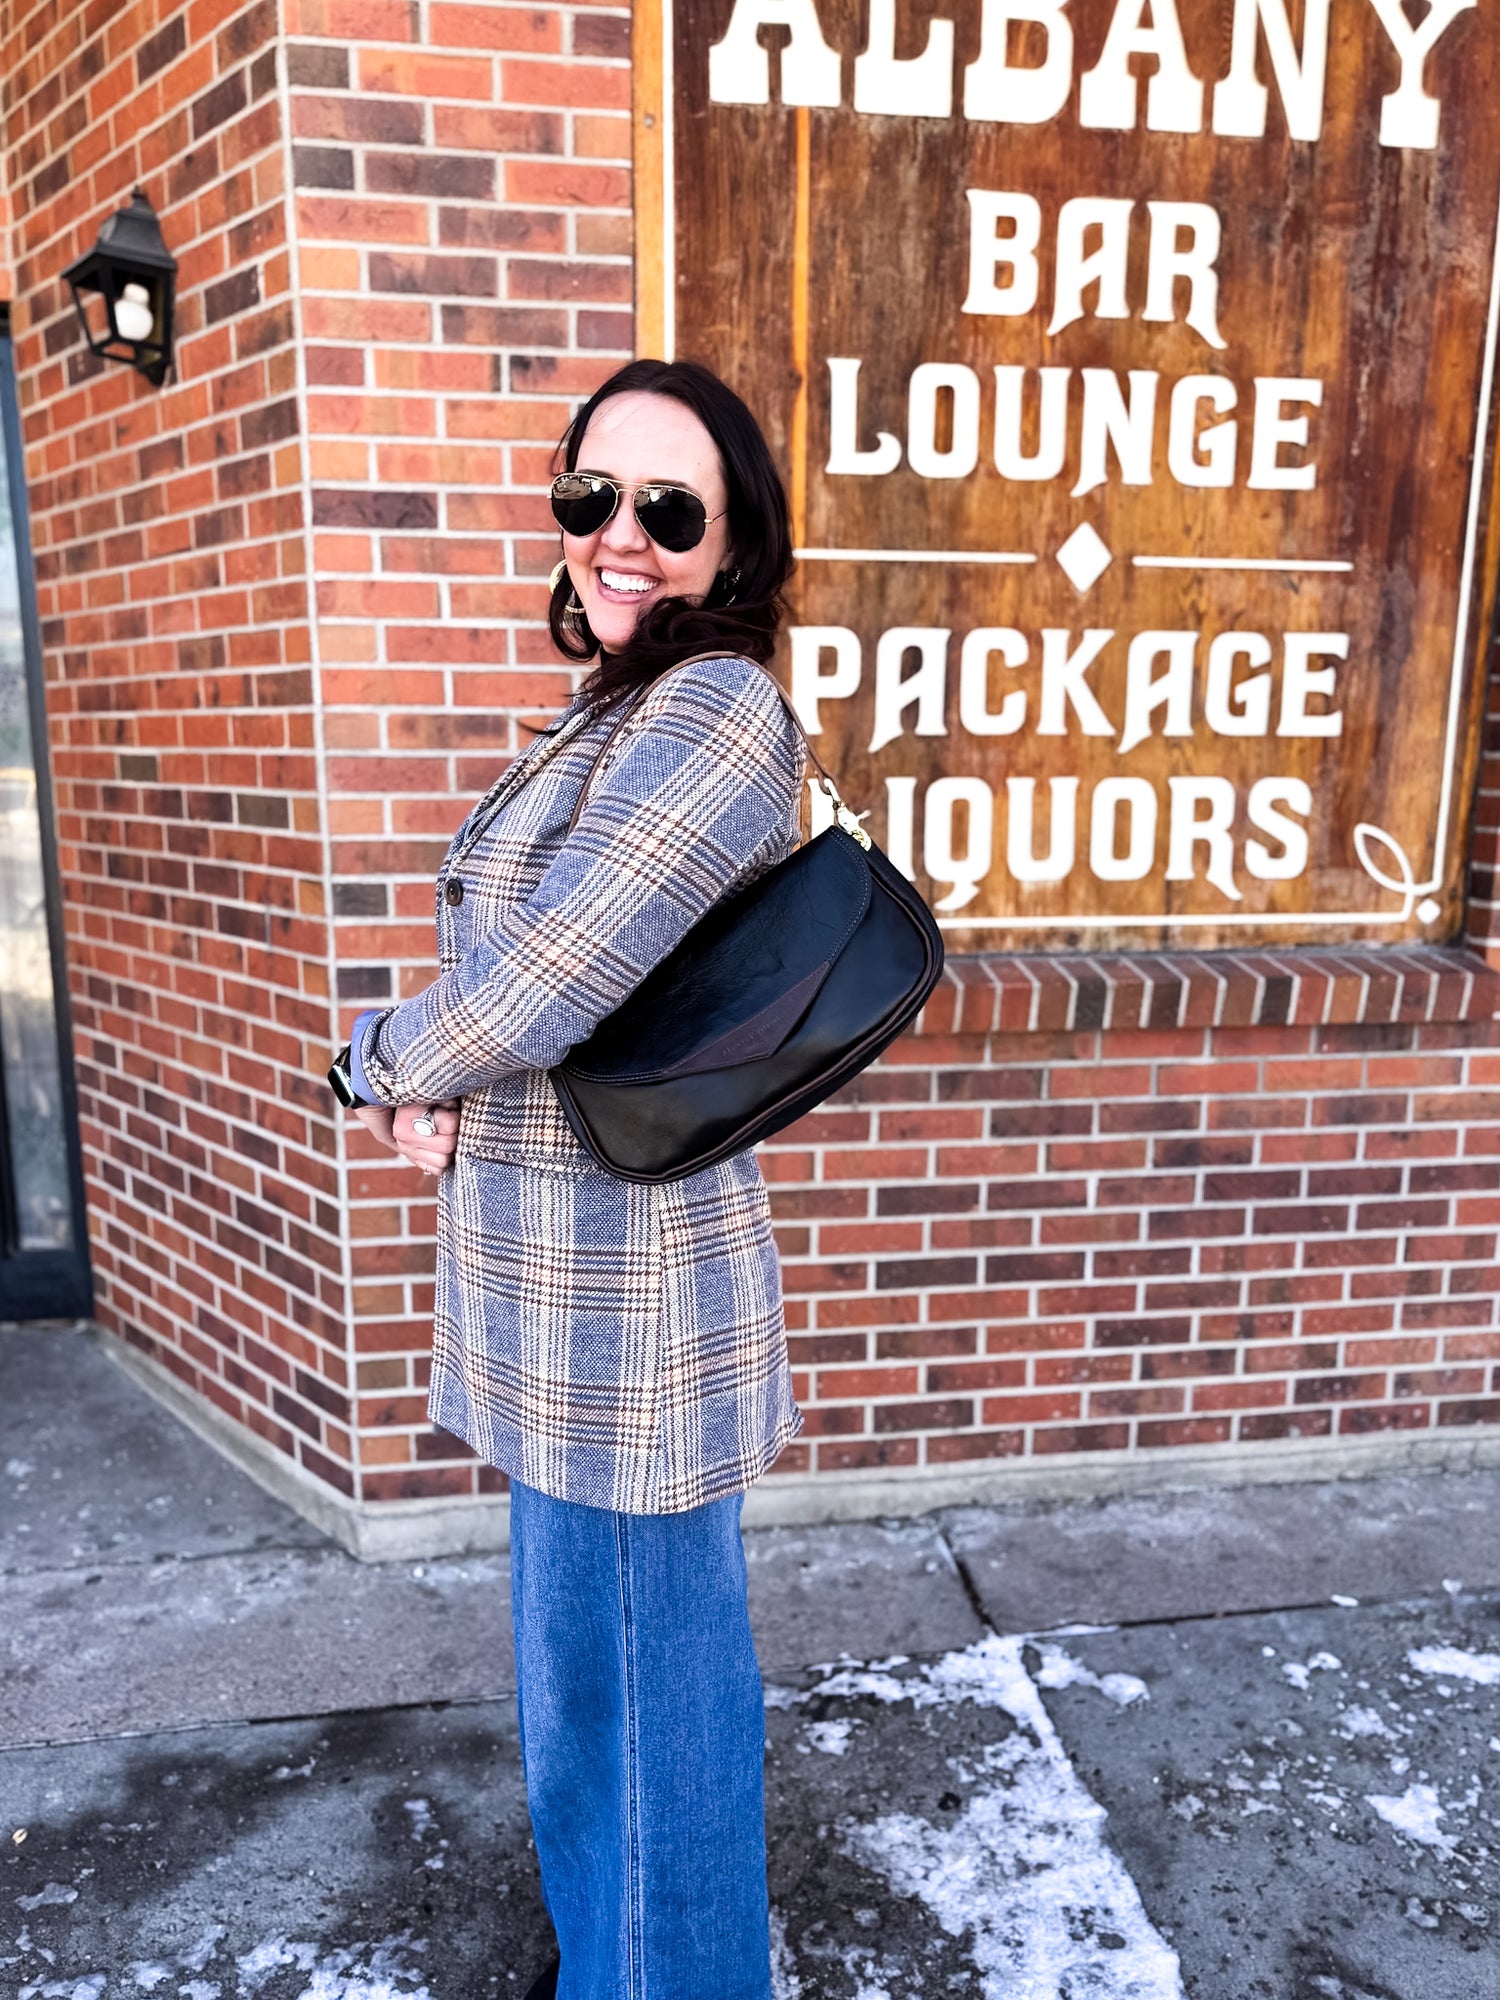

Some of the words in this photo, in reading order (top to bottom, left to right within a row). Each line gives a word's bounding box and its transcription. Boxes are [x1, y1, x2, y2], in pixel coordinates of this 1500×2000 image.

[961, 189, 1227, 349] BAR
[825, 357, 1323, 498] LOUNGE
[788, 626, 1349, 753] PACKAGE
